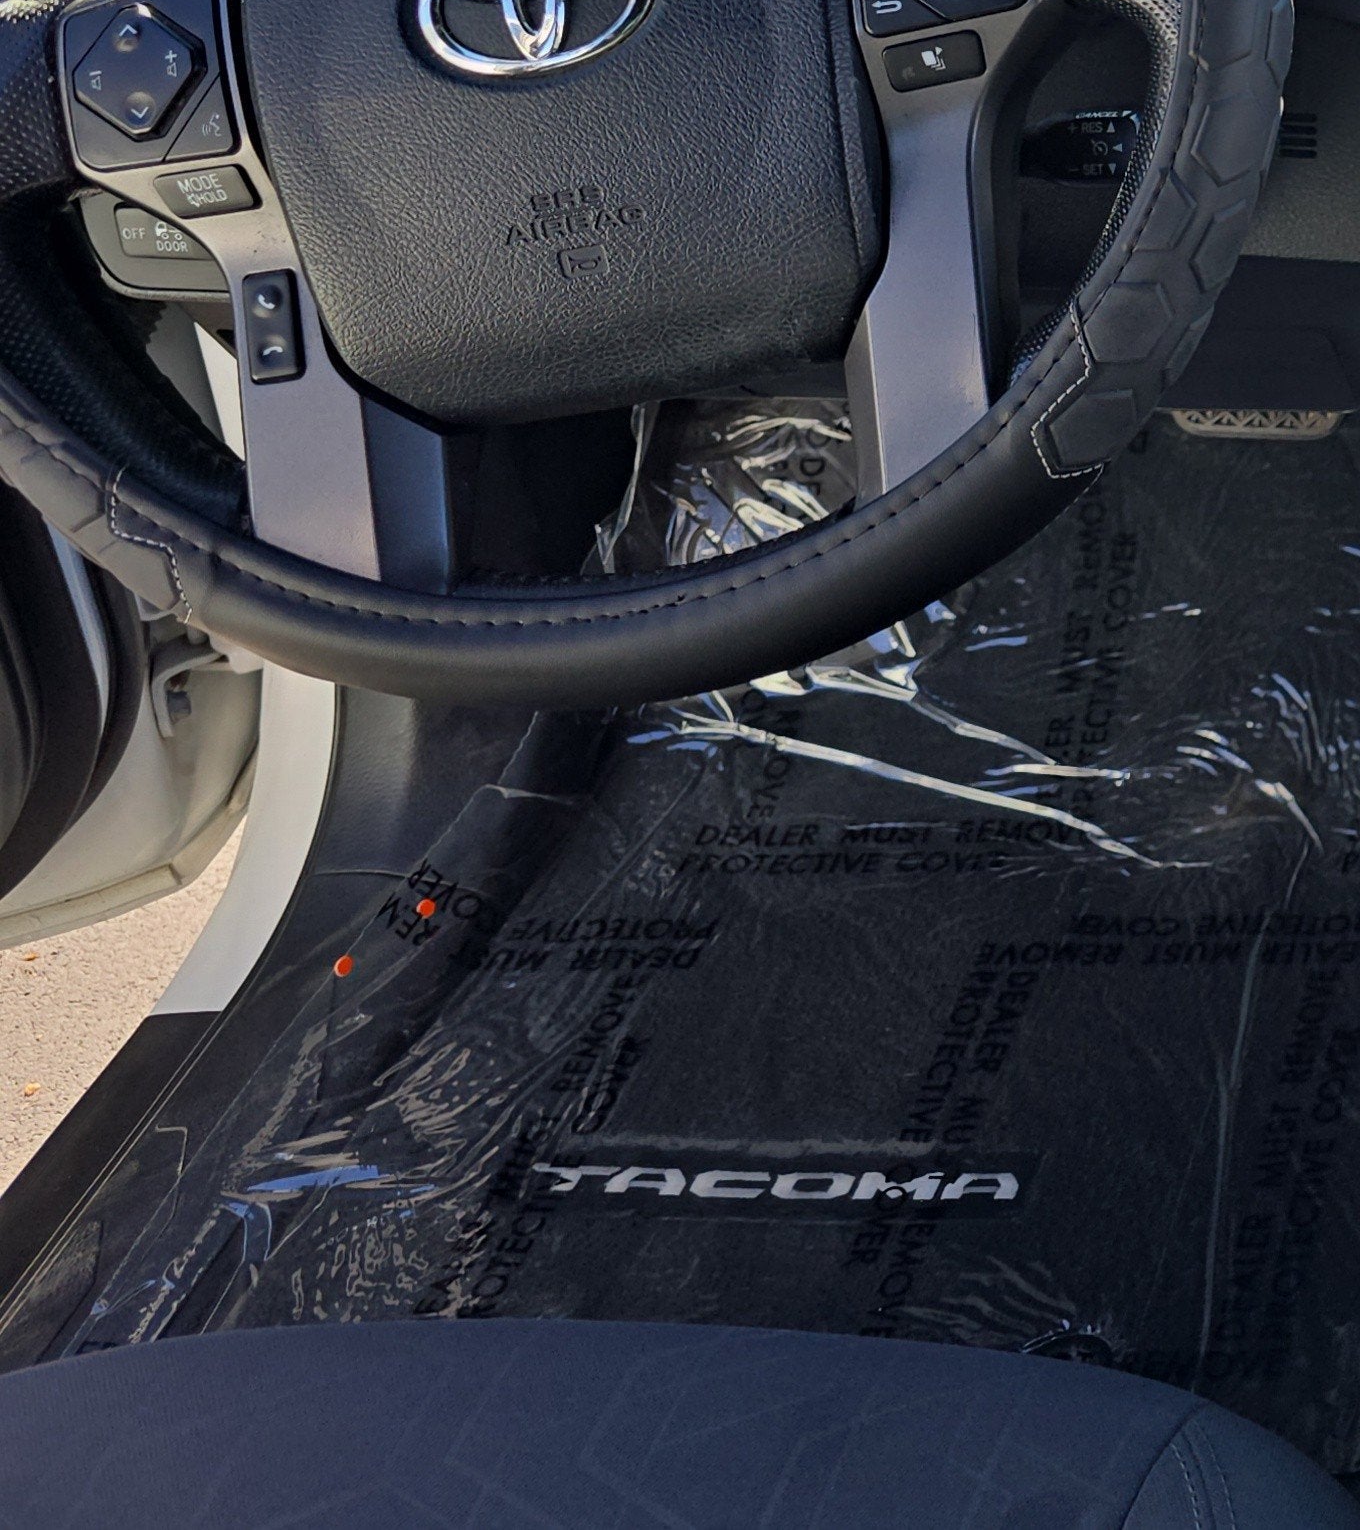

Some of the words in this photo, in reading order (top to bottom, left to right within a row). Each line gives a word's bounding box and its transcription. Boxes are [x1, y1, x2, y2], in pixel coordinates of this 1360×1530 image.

[1081, 121, 1104, 134] RES
[177, 172, 223, 194] MODE
[122, 226, 146, 241] OFF
[156, 240, 189, 253] DOOR
[1102, 530, 1139, 633] COVER
[694, 825, 819, 848] DEALER
[842, 825, 934, 845] MUST
[677, 852, 882, 873] PROTECTIVE
[511, 917, 723, 943] PROTECTIVE
[1070, 913, 1181, 937] COVER
[569, 946, 703, 970] DEALER
[974, 940, 1124, 966] REMOVE
[1141, 940, 1243, 965] MUST
[551, 974, 654, 1093] REMOVE
[970, 971, 1040, 1074] DEALER
[901, 971, 1000, 1143] PROTECTIVE
[1213, 1212, 1276, 1344] DEALER
[1252, 1101, 1302, 1189] MUST
[1279, 969, 1342, 1084] REMOVE
[532, 1161, 1020, 1201] TACOMA
